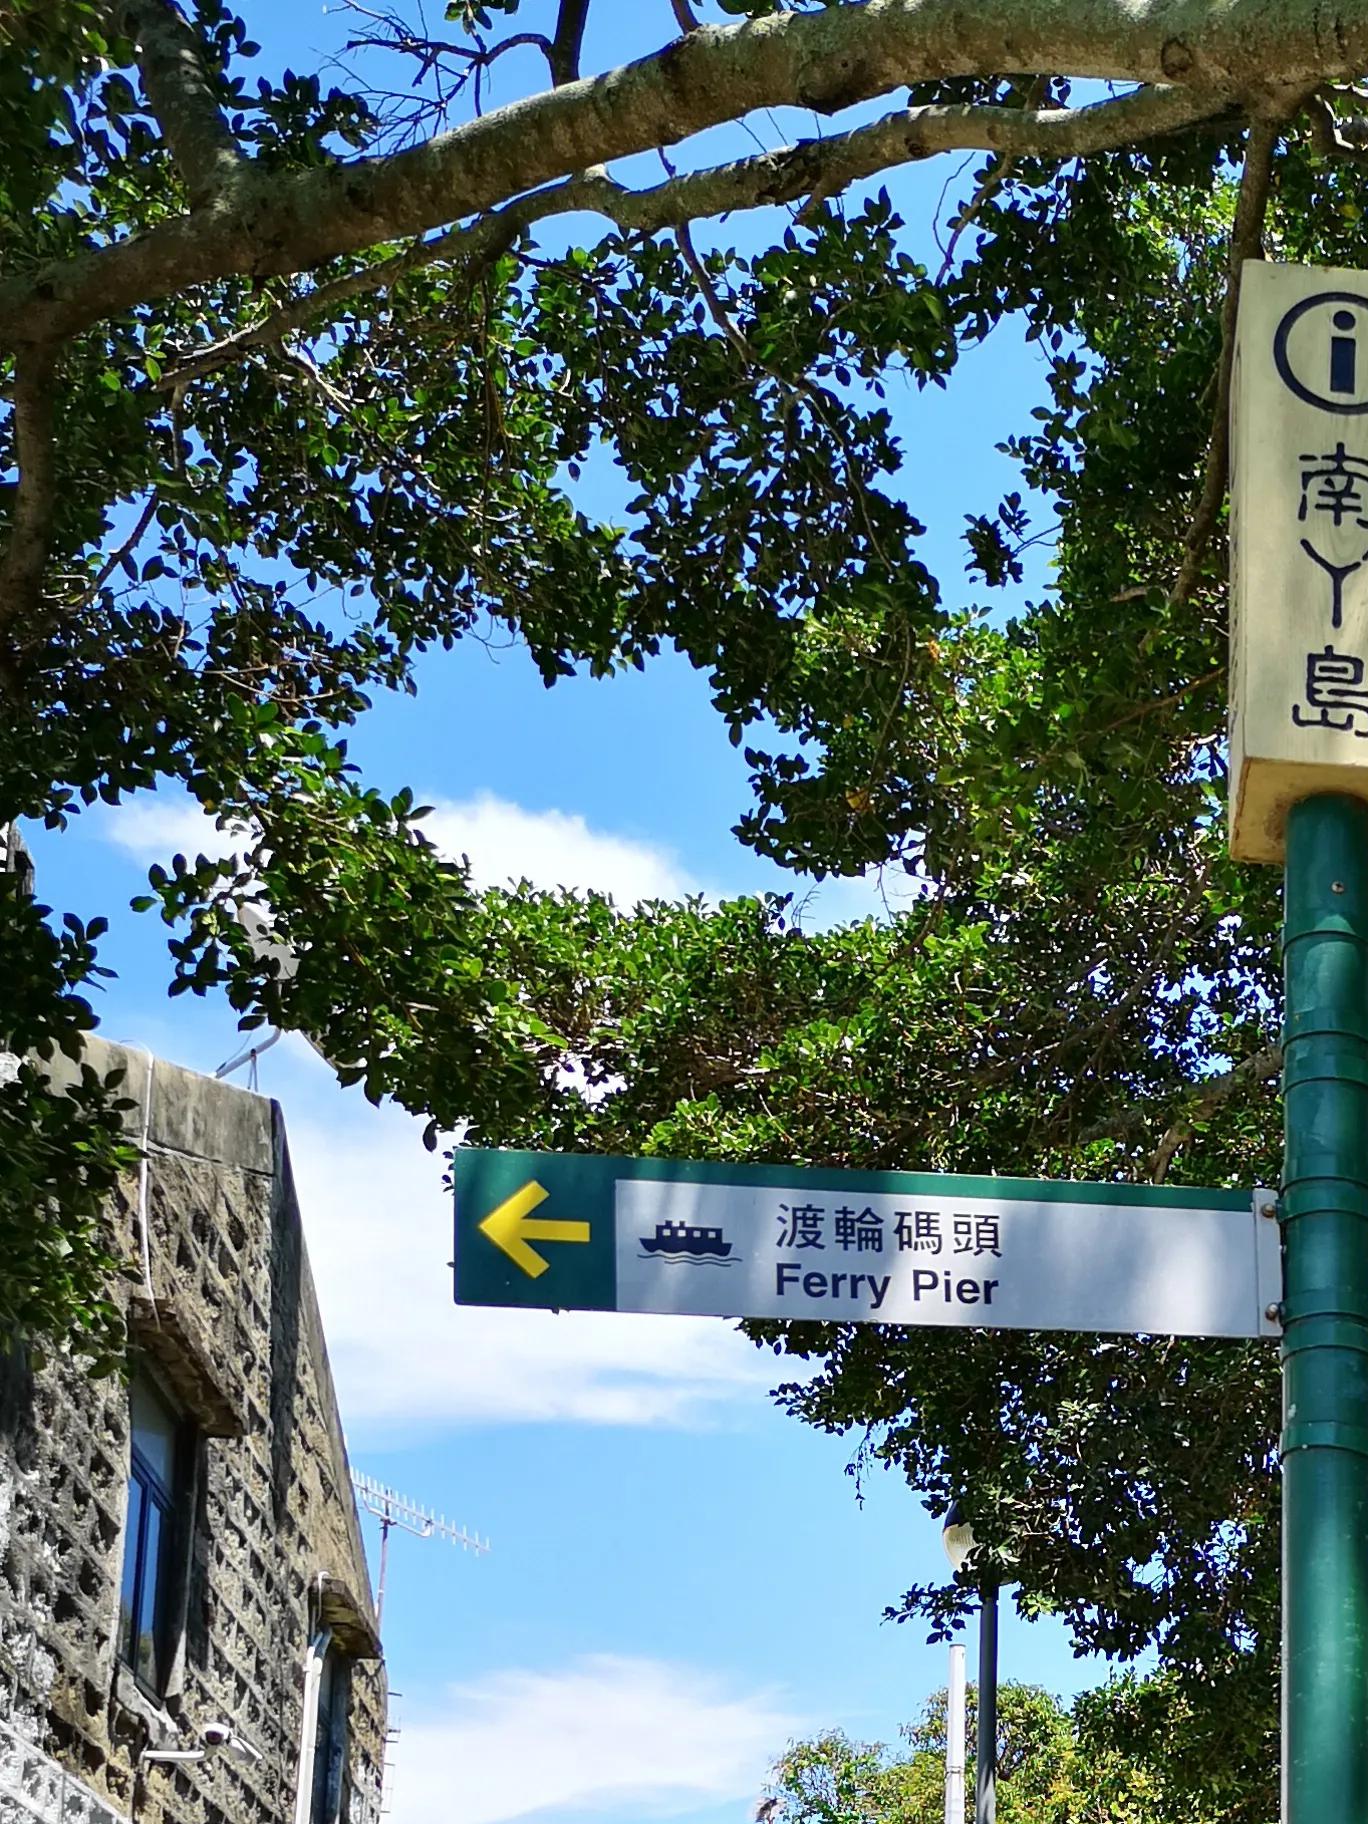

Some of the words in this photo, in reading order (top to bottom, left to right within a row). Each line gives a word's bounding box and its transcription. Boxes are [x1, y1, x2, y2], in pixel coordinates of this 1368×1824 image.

[775, 1203, 1003, 1258] 渡輪碼頭
[775, 1262, 892, 1308] Ferry
[913, 1268, 1000, 1305] Pier
